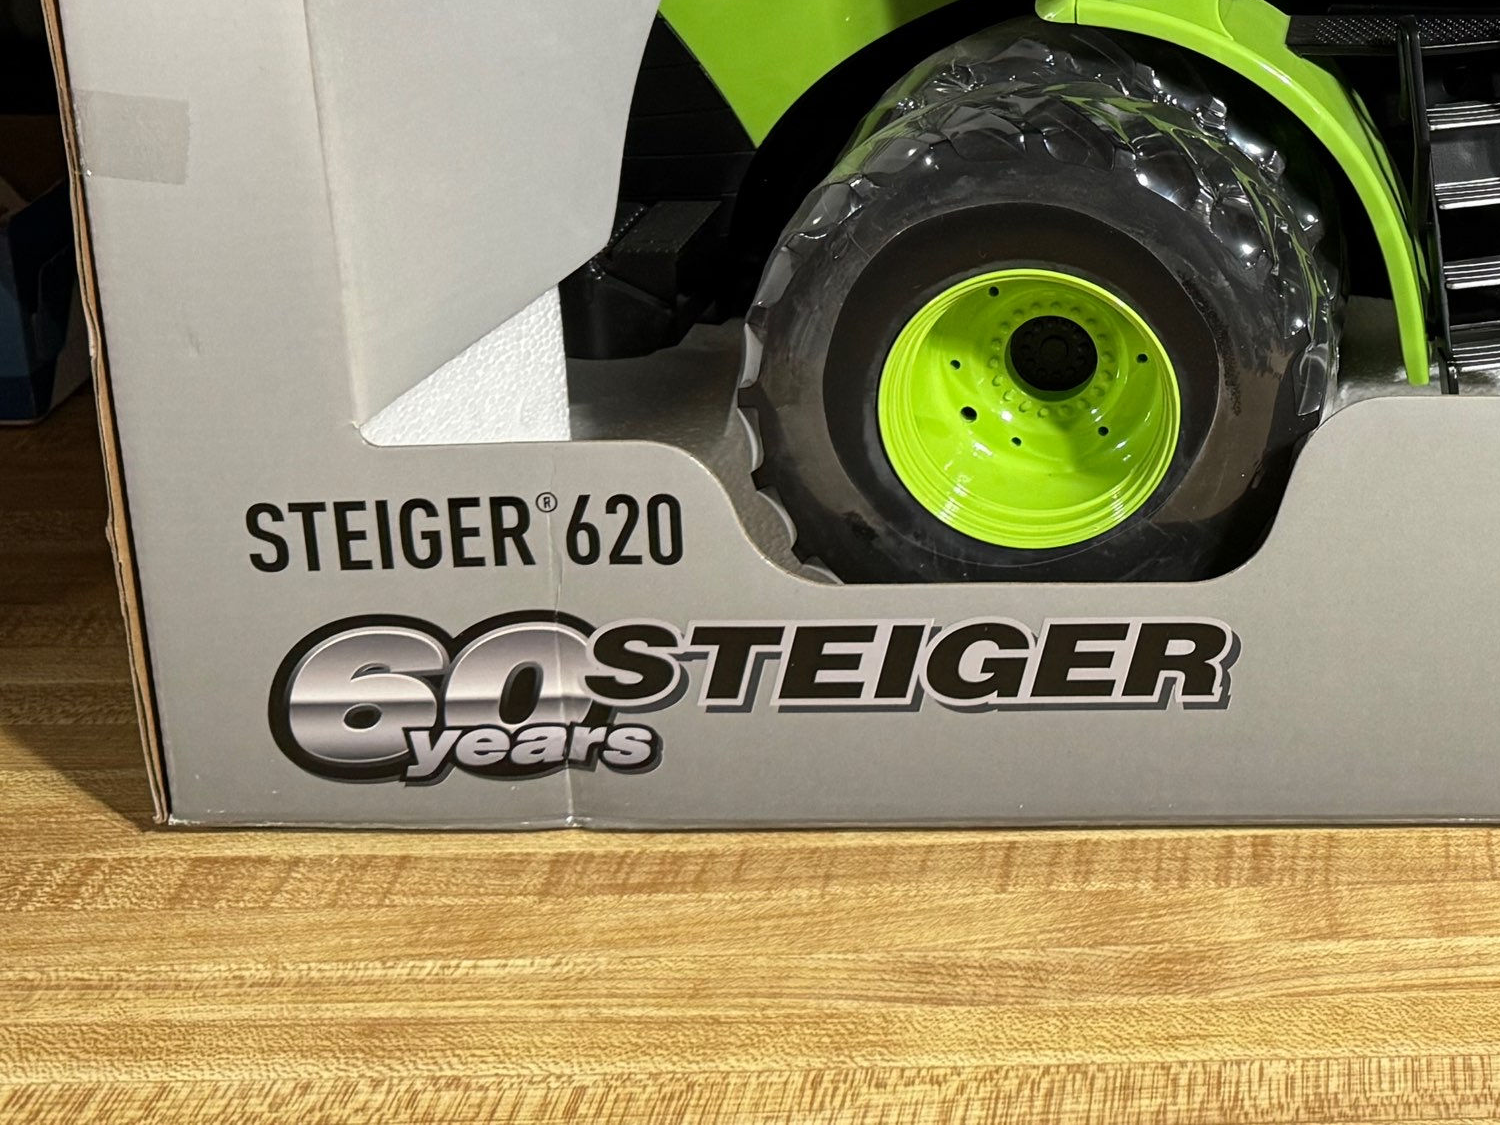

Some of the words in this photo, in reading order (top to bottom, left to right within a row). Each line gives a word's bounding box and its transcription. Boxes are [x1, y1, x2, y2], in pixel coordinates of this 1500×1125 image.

[565, 493, 684, 566] 620
[268, 609, 606, 783] 60
[584, 617, 1241, 713] STEIGER
[402, 721, 664, 786] years
